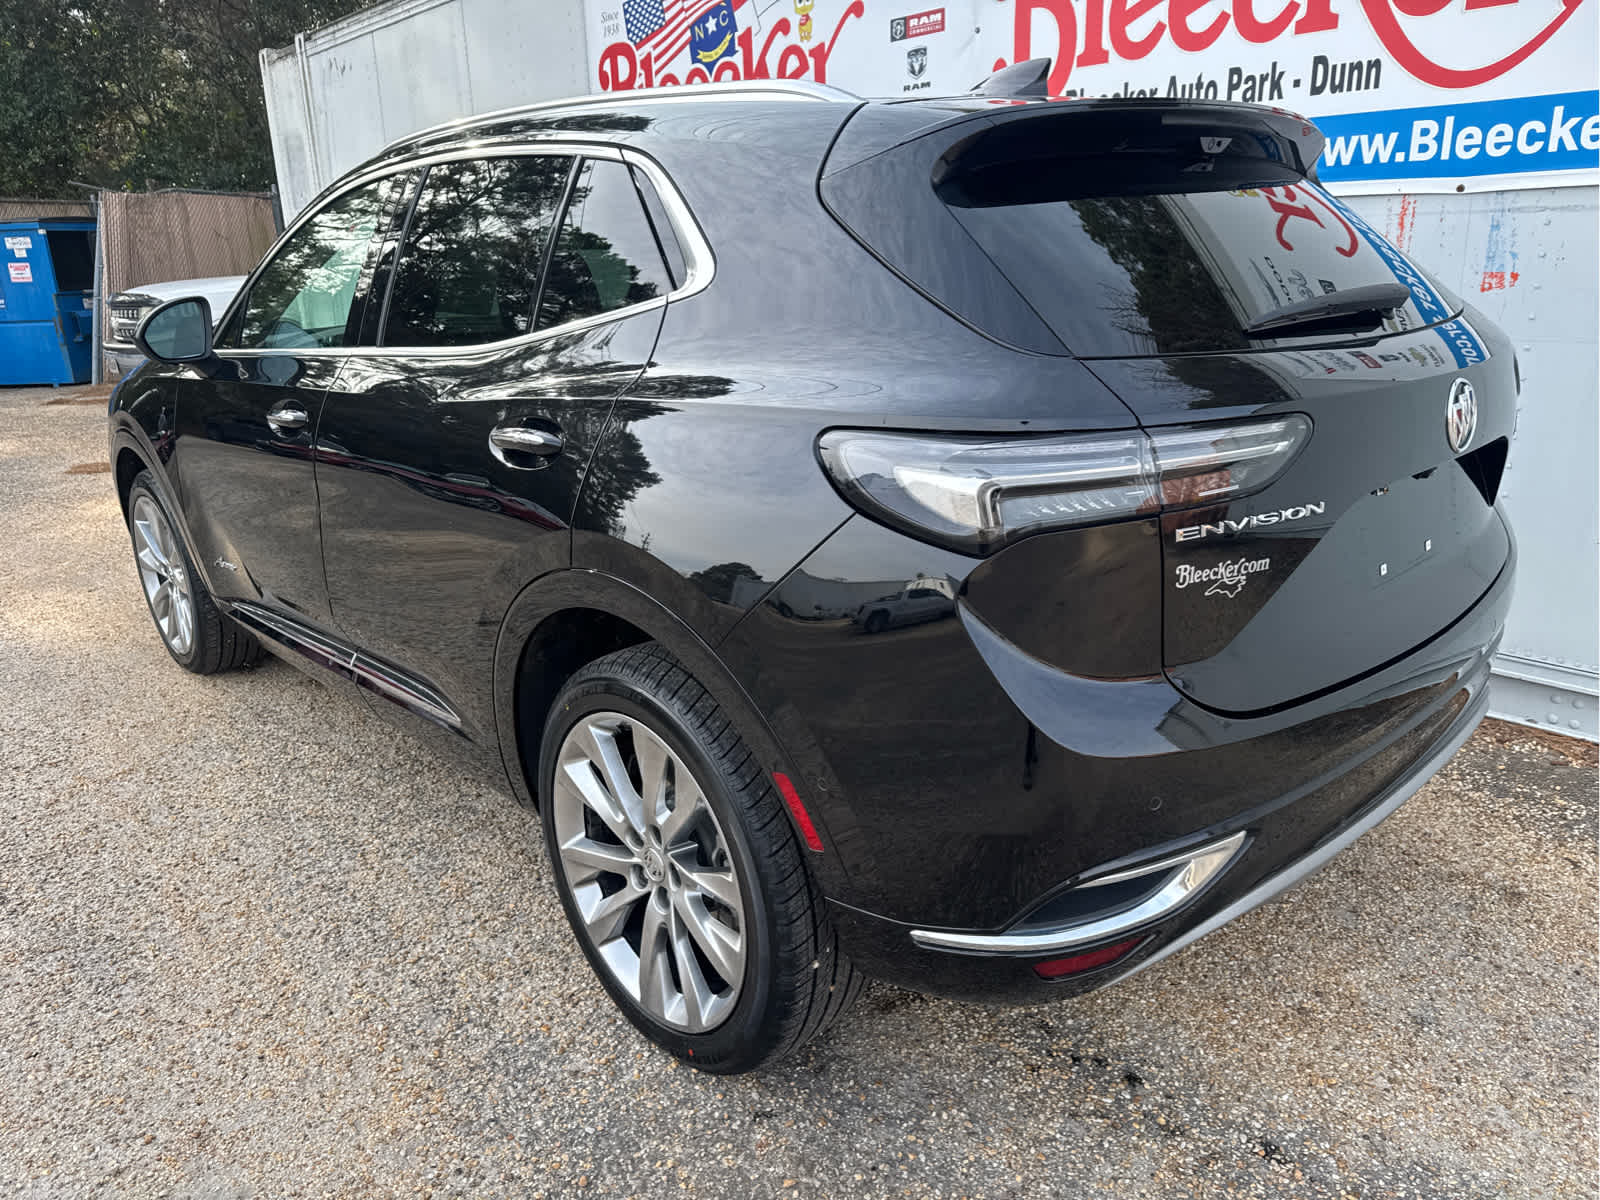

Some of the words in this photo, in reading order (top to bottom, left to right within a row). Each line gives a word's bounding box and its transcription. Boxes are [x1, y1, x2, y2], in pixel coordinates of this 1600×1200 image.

[909, 13, 943, 28] RAM
[904, 81, 931, 92] RAM
[1226, 61, 1285, 103] Park
[1309, 54, 1382, 96] Dunn
[1175, 501, 1325, 543] ENVISION
